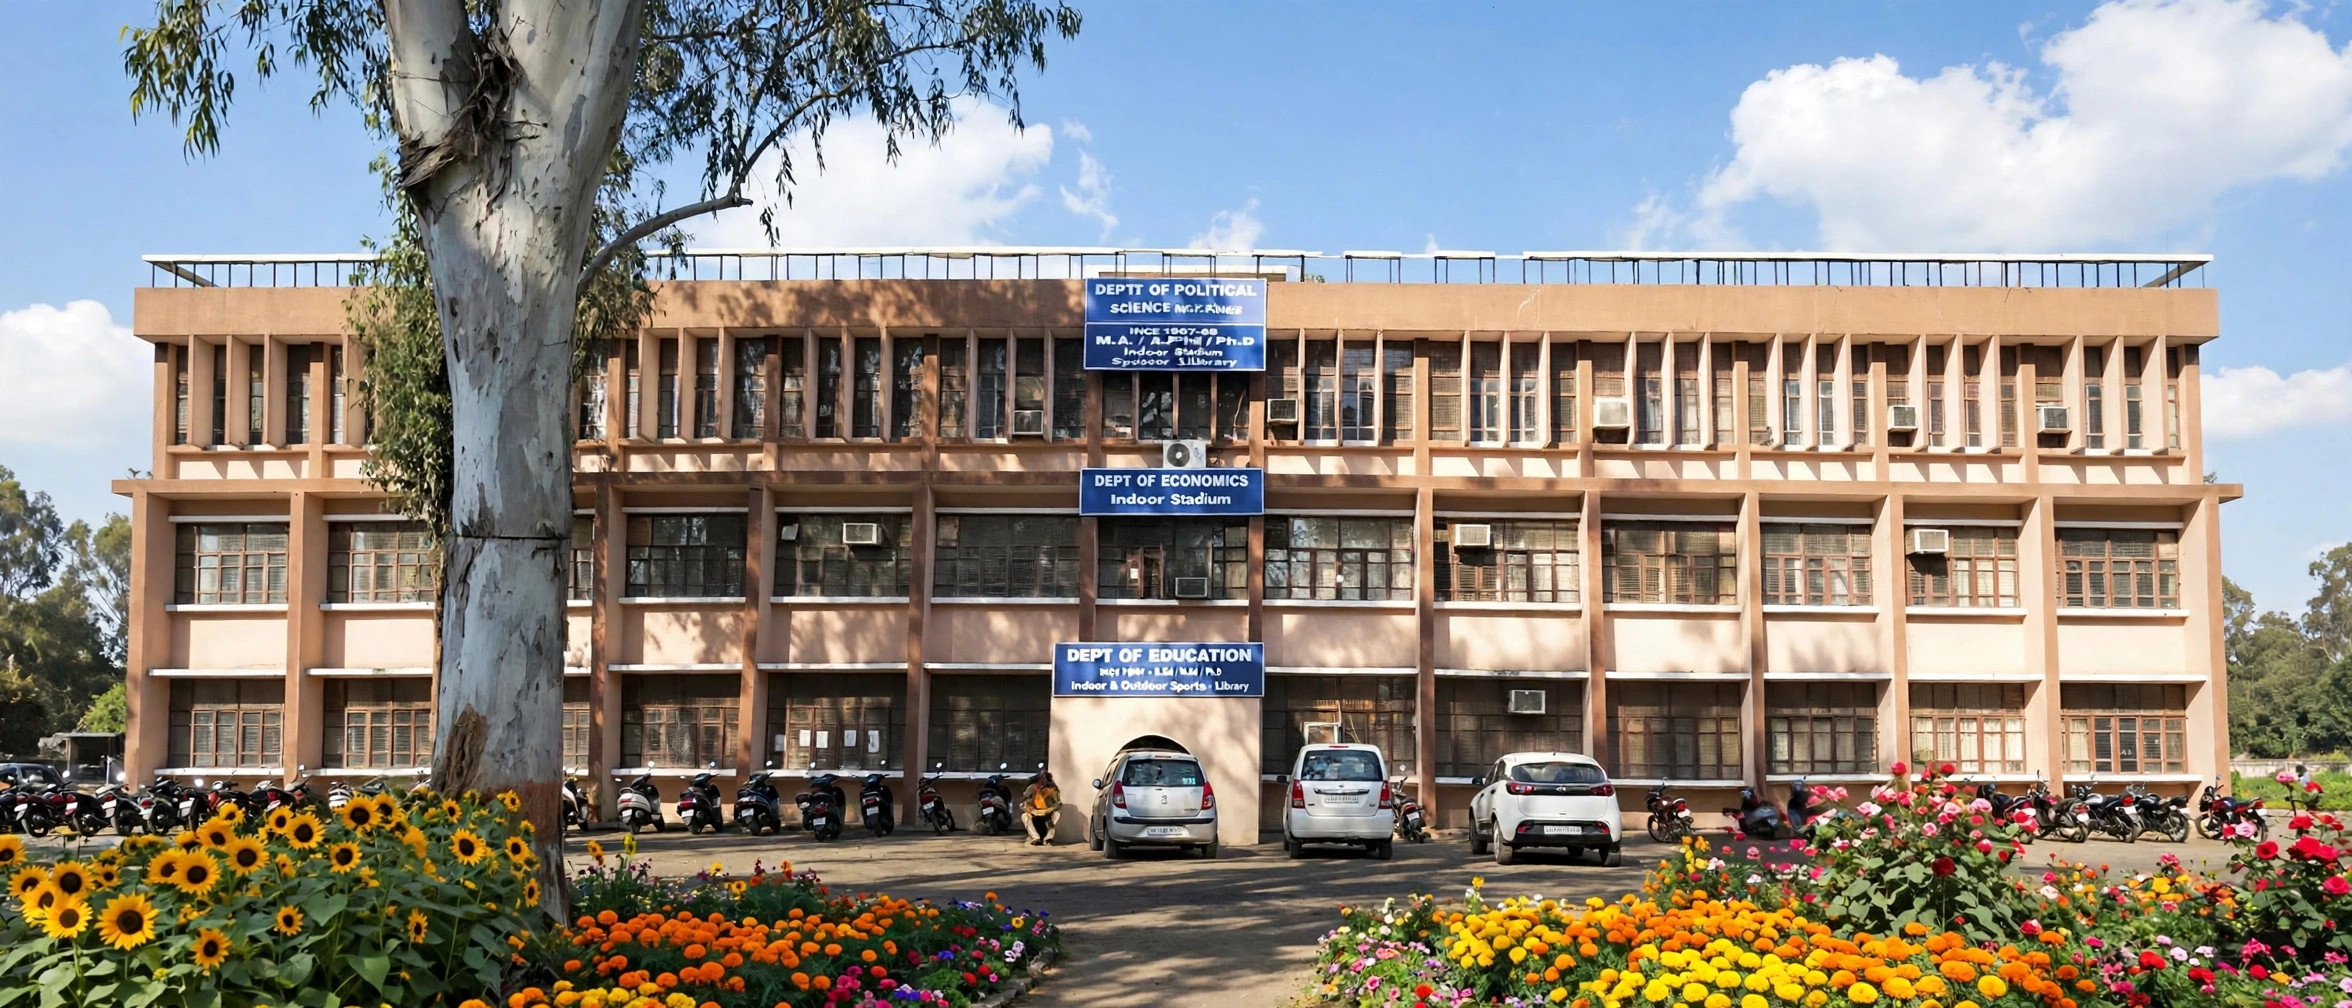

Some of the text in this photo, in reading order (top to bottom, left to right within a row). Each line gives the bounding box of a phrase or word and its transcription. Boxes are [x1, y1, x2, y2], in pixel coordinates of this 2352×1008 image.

[1149, 284, 1170, 296] OF
[1174, 284, 1257, 296] POLITICAL
[1109, 302, 1171, 314] SCIENCE
[1095, 335, 1133, 345] M.A.
[1216, 336, 1255, 346] Ph.D
[1094, 474, 1249, 487] DEPT OF ECONOMICS
[1110, 492, 1231, 505] Indoor Stadium
[1067, 648, 1252, 663] DEPT OF EDUCATION
[1170, 681, 1207, 693] Sports
[1215, 681, 1249, 692] Library
